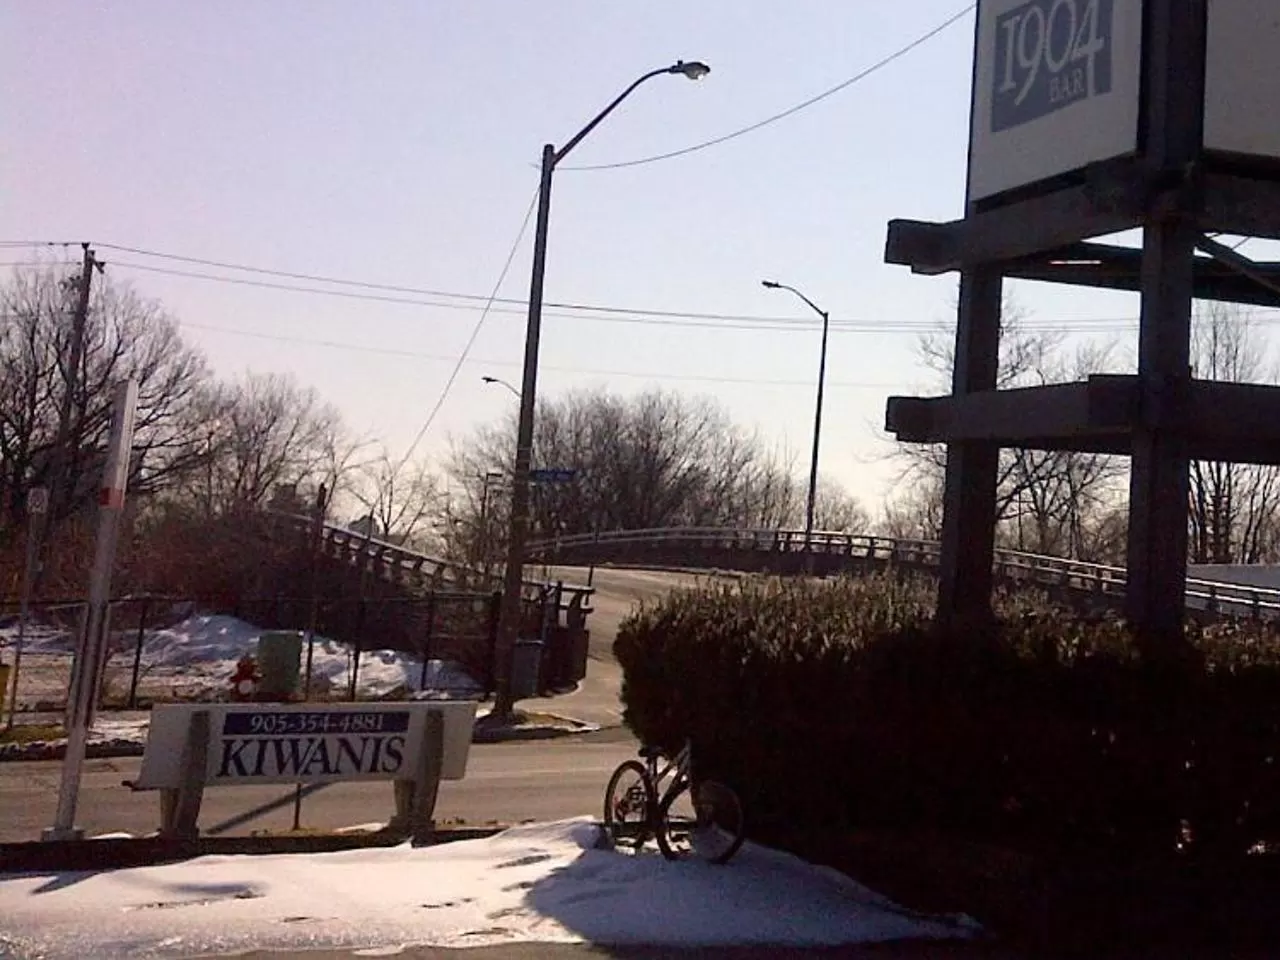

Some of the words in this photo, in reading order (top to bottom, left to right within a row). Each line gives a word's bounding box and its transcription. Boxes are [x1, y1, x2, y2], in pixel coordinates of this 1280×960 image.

[1049, 67, 1085, 103] BAR
[250, 713, 384, 733] 905-354-4881
[215, 735, 406, 778] KIWANIS
